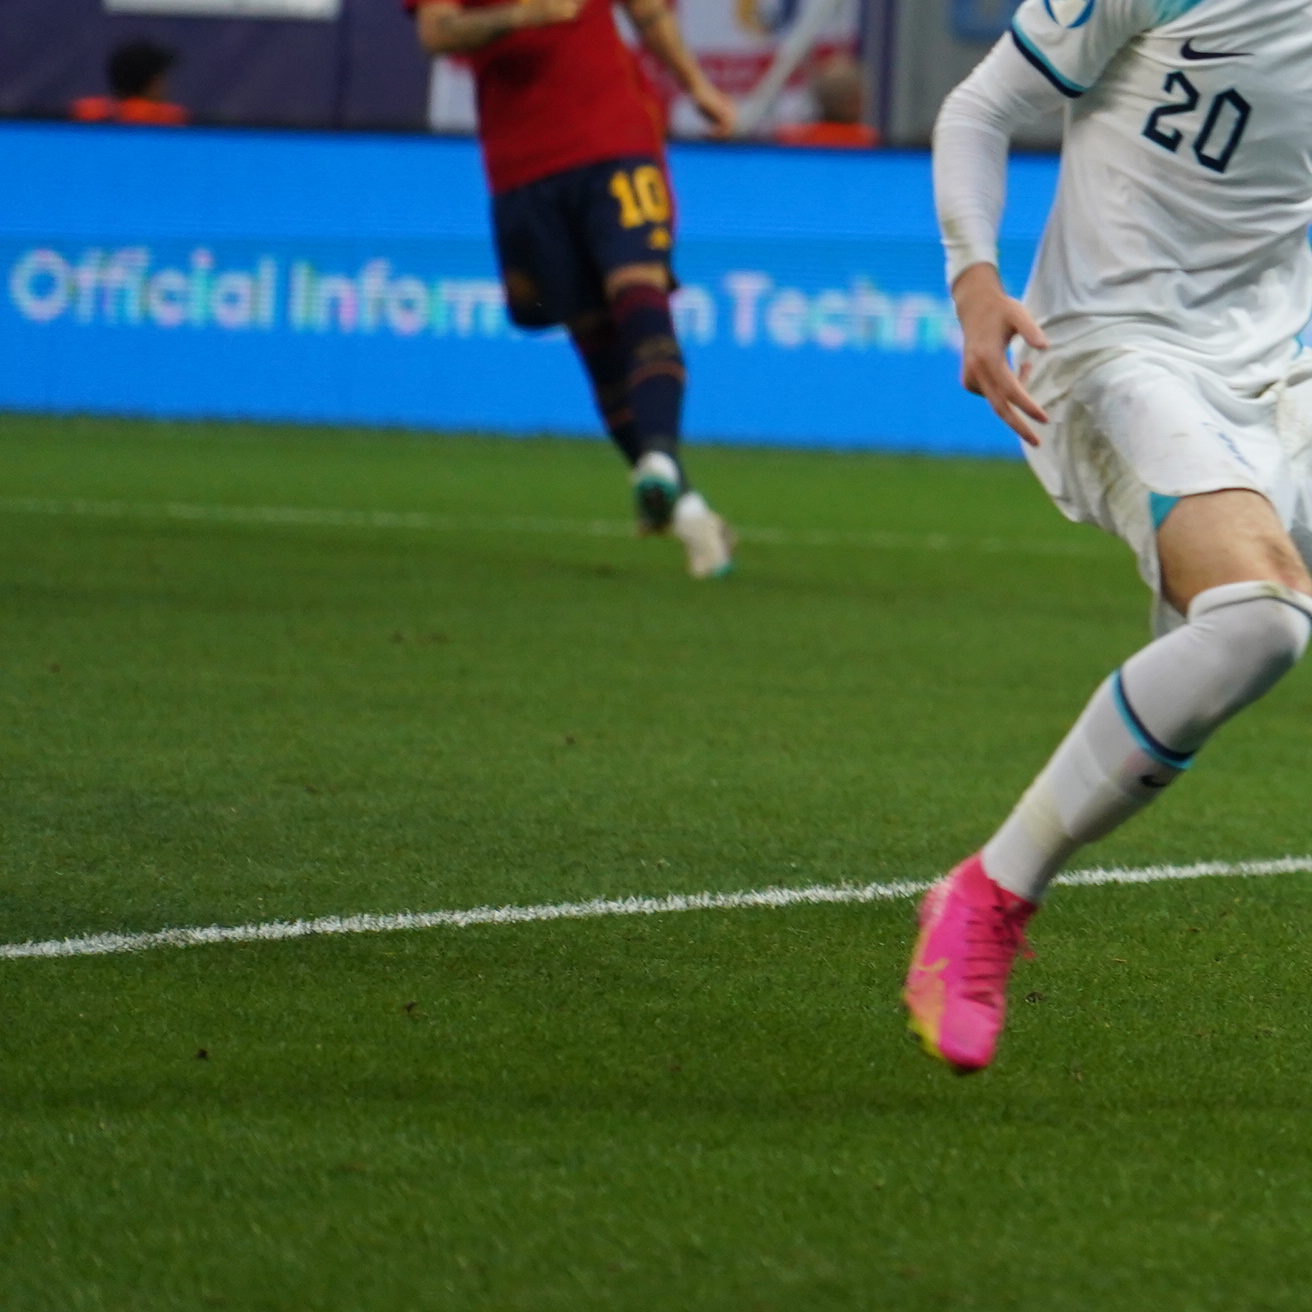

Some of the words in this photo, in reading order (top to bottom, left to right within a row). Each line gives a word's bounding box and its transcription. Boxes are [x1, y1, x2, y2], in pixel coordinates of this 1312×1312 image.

[1142, 70, 1252, 174] 20
[609, 165, 670, 229] 10
[10, 246, 276, 328] Official
